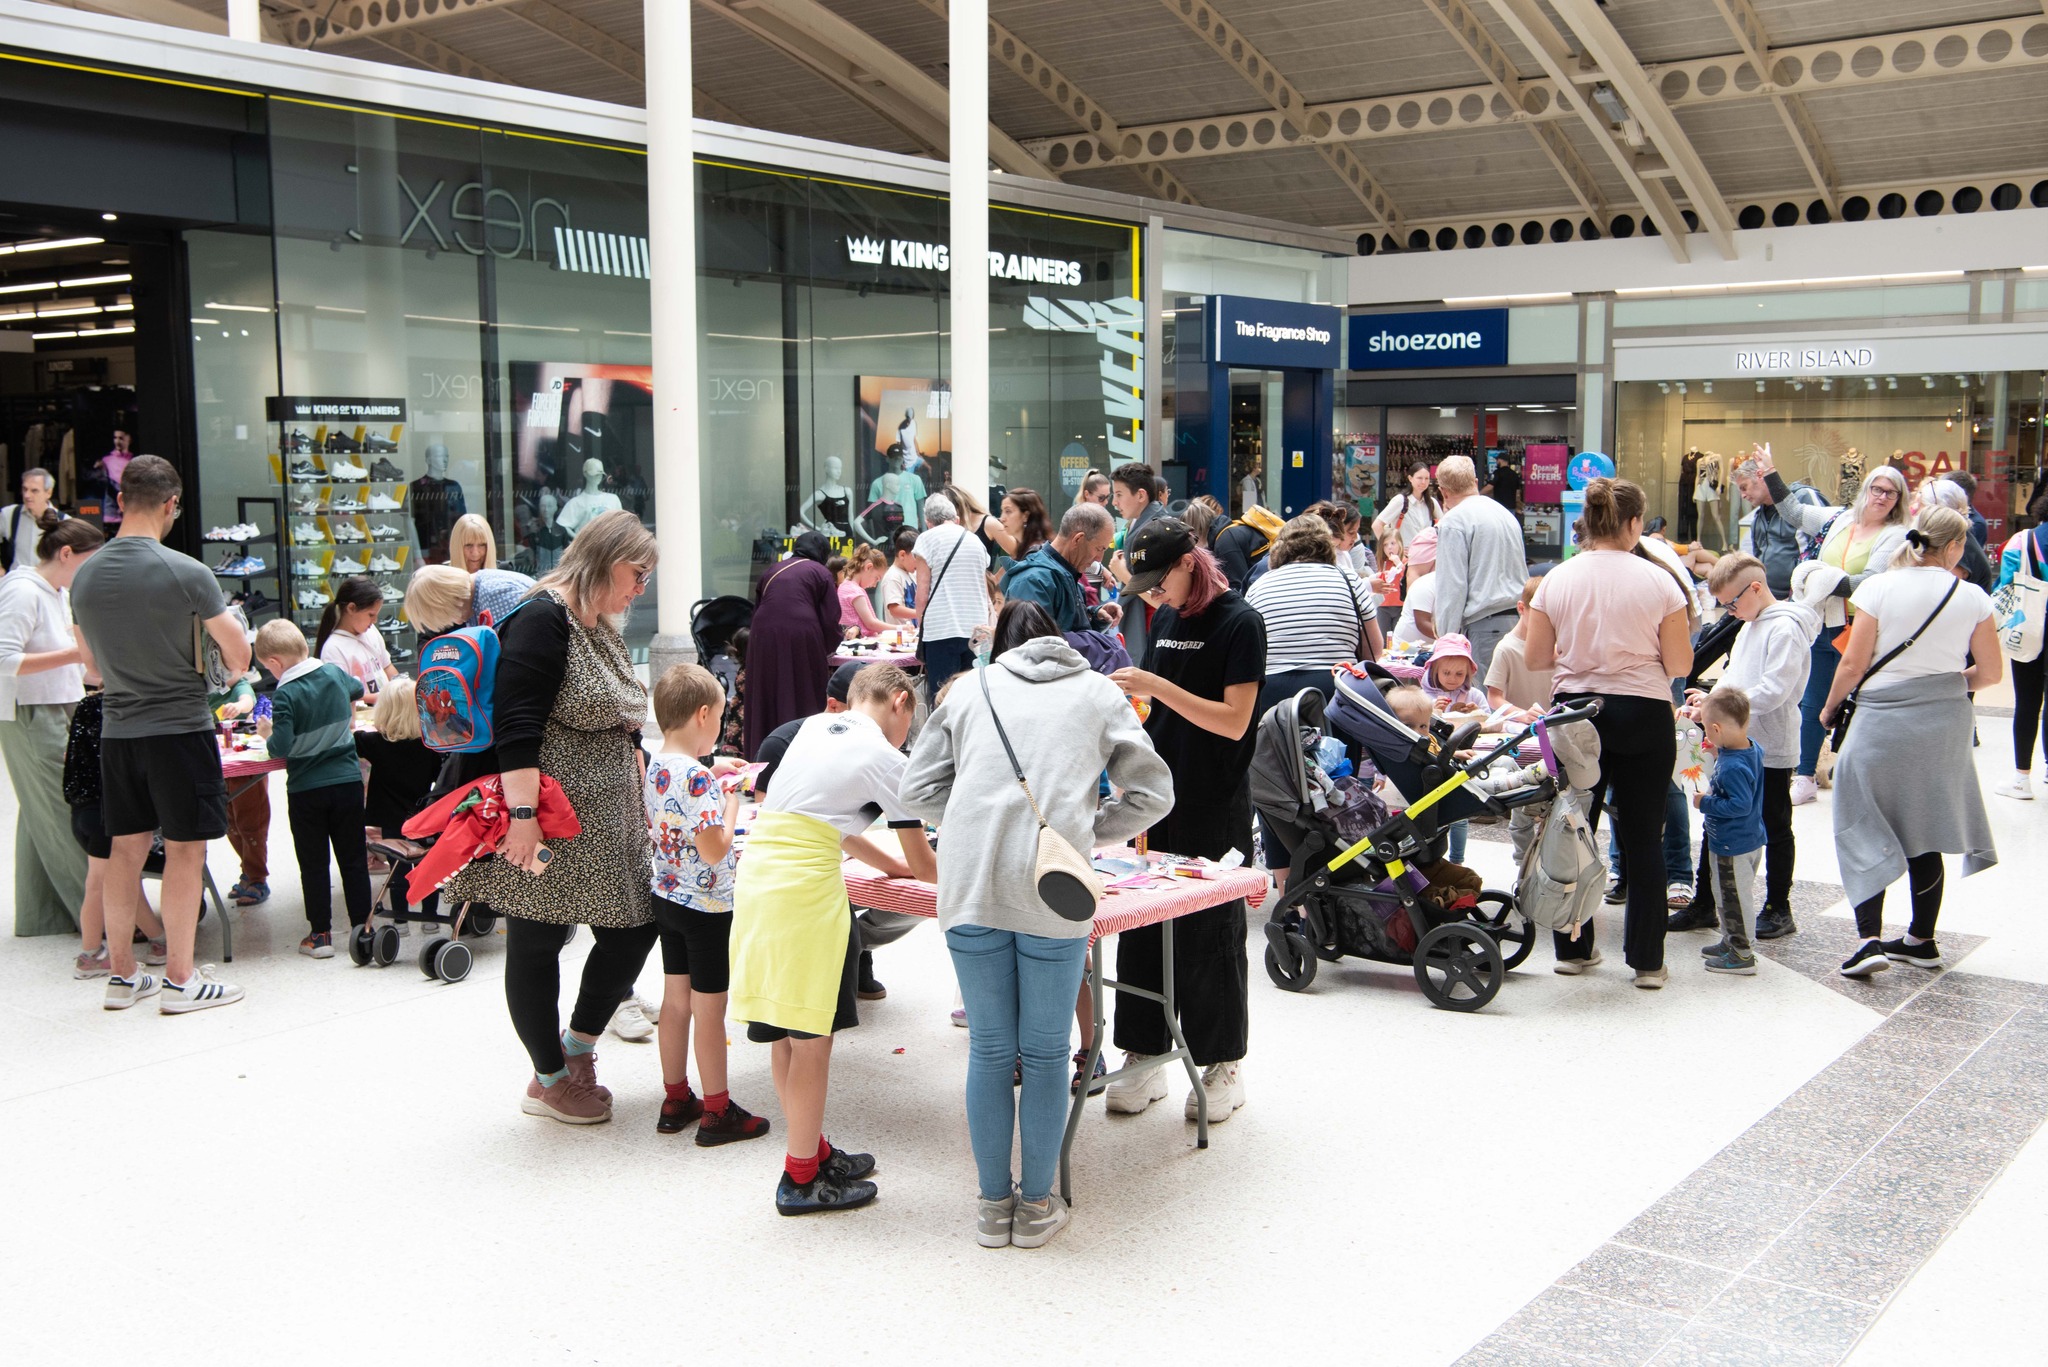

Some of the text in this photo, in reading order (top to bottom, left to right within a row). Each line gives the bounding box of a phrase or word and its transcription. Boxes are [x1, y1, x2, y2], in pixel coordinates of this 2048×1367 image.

[891, 239, 1082, 286] KING RAINERS
[1235, 321, 1330, 345] The Fragrance Shop
[1369, 330, 1481, 352] shoezone
[1737, 349, 1872, 369] RIVER ISLAND
[313, 405, 401, 415] KING OF TRAINERS
[1060, 456, 1090, 469] OFFERS
[1530, 472, 1562, 481] OFFERS
